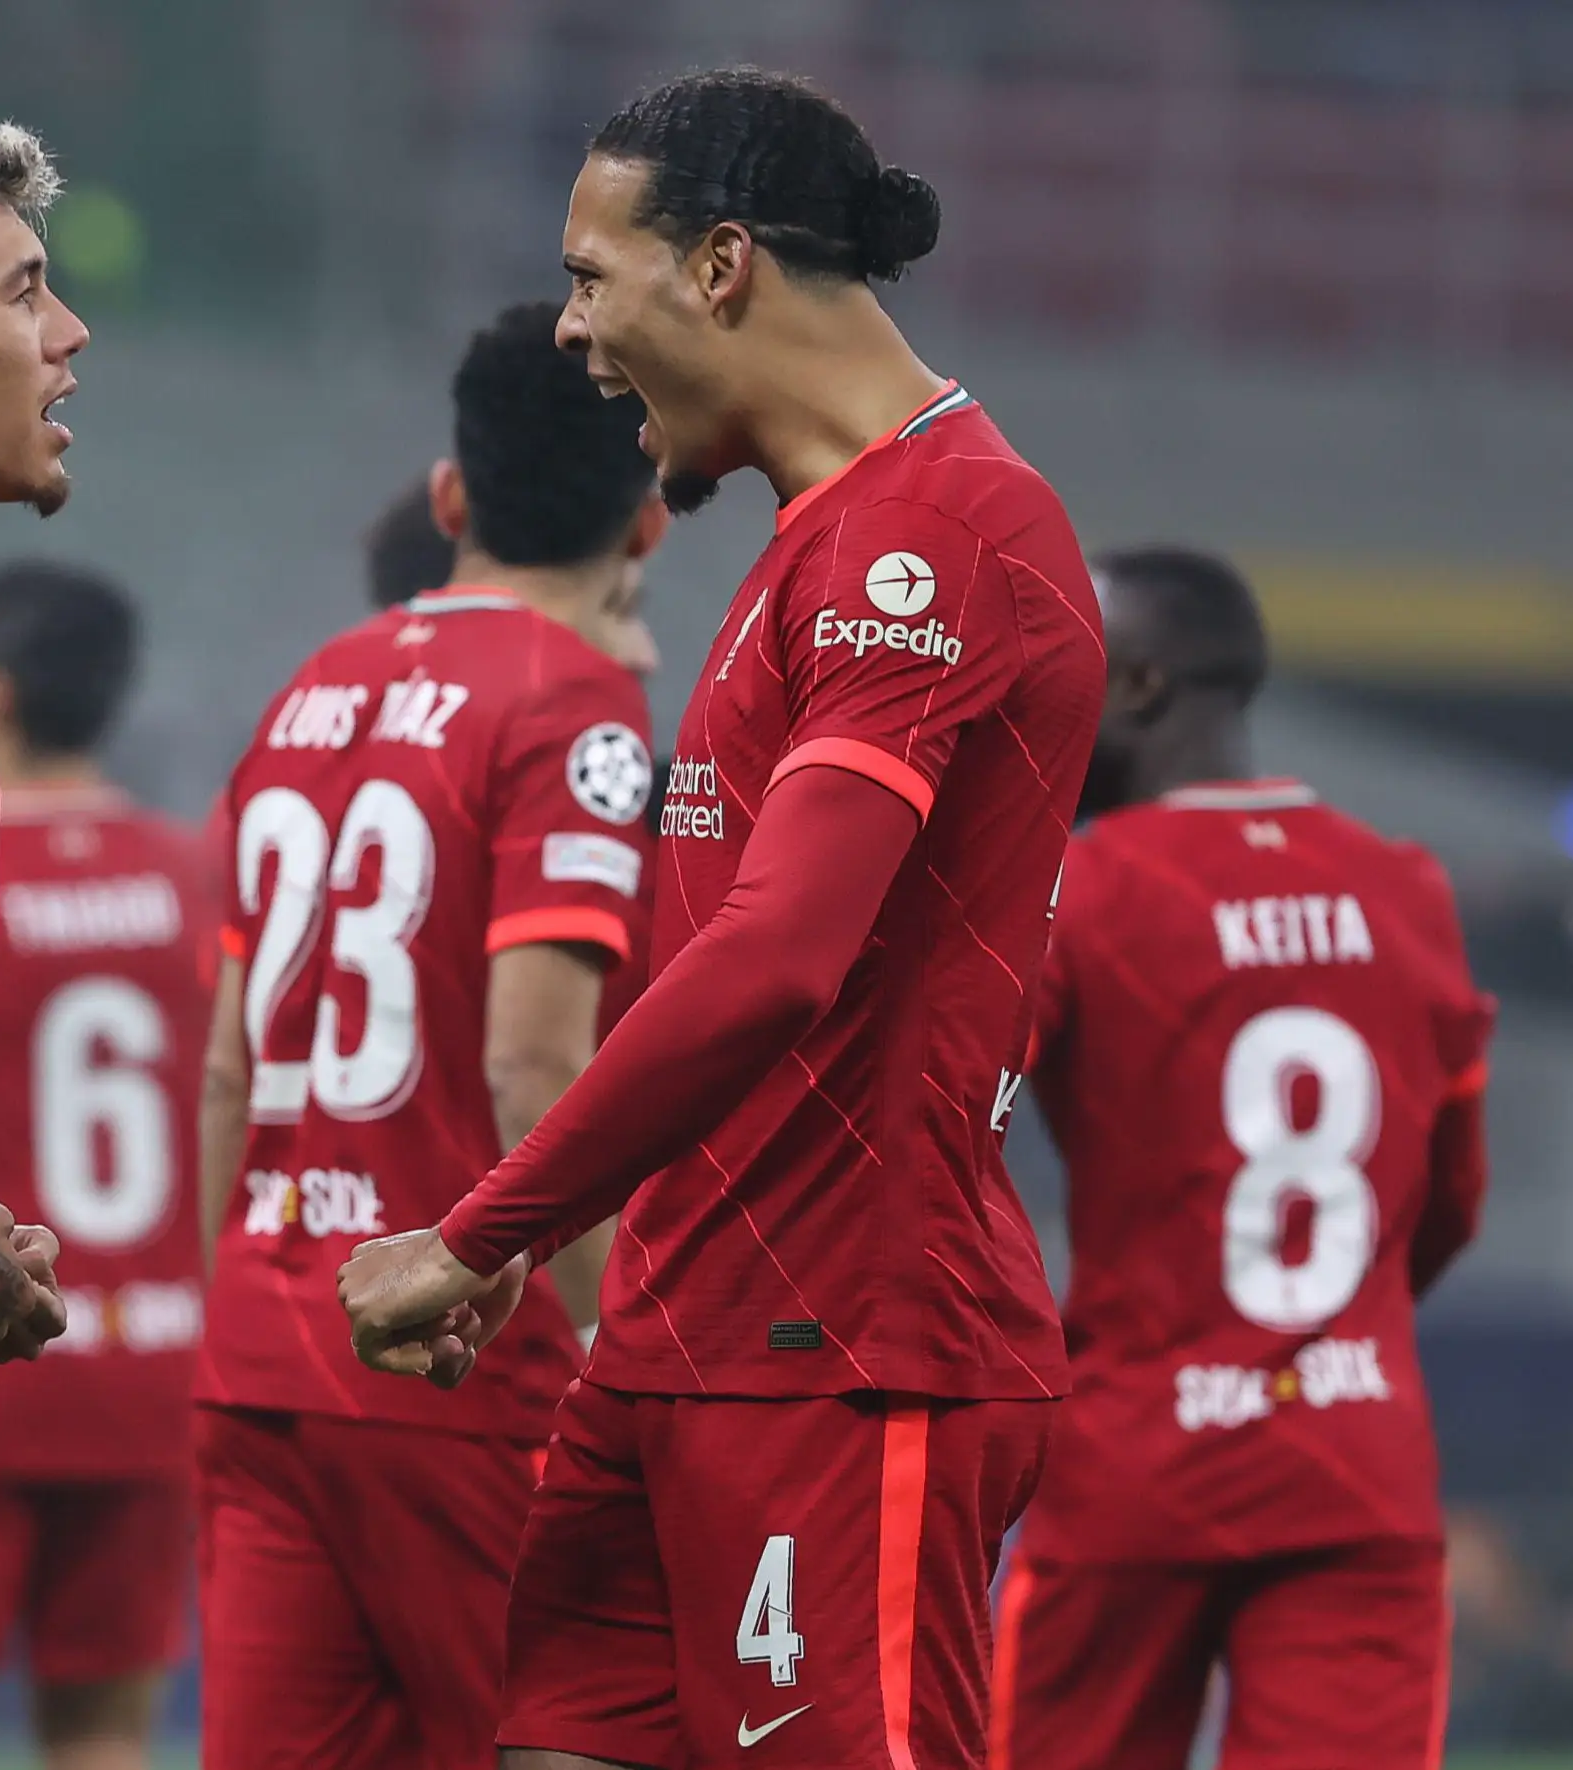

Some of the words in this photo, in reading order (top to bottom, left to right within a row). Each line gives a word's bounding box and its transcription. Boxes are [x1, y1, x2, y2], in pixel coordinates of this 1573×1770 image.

[814, 608, 963, 666] Expedia
[660, 796, 725, 840] chtered
[666, 754, 717, 797] stdrd
[237, 779, 436, 1124] 23
[1211, 893, 1376, 970] KEITA
[33, 976, 174, 1250] 6
[1222, 1006, 1381, 1333] 8
[736, 1535, 803, 1686] 4
